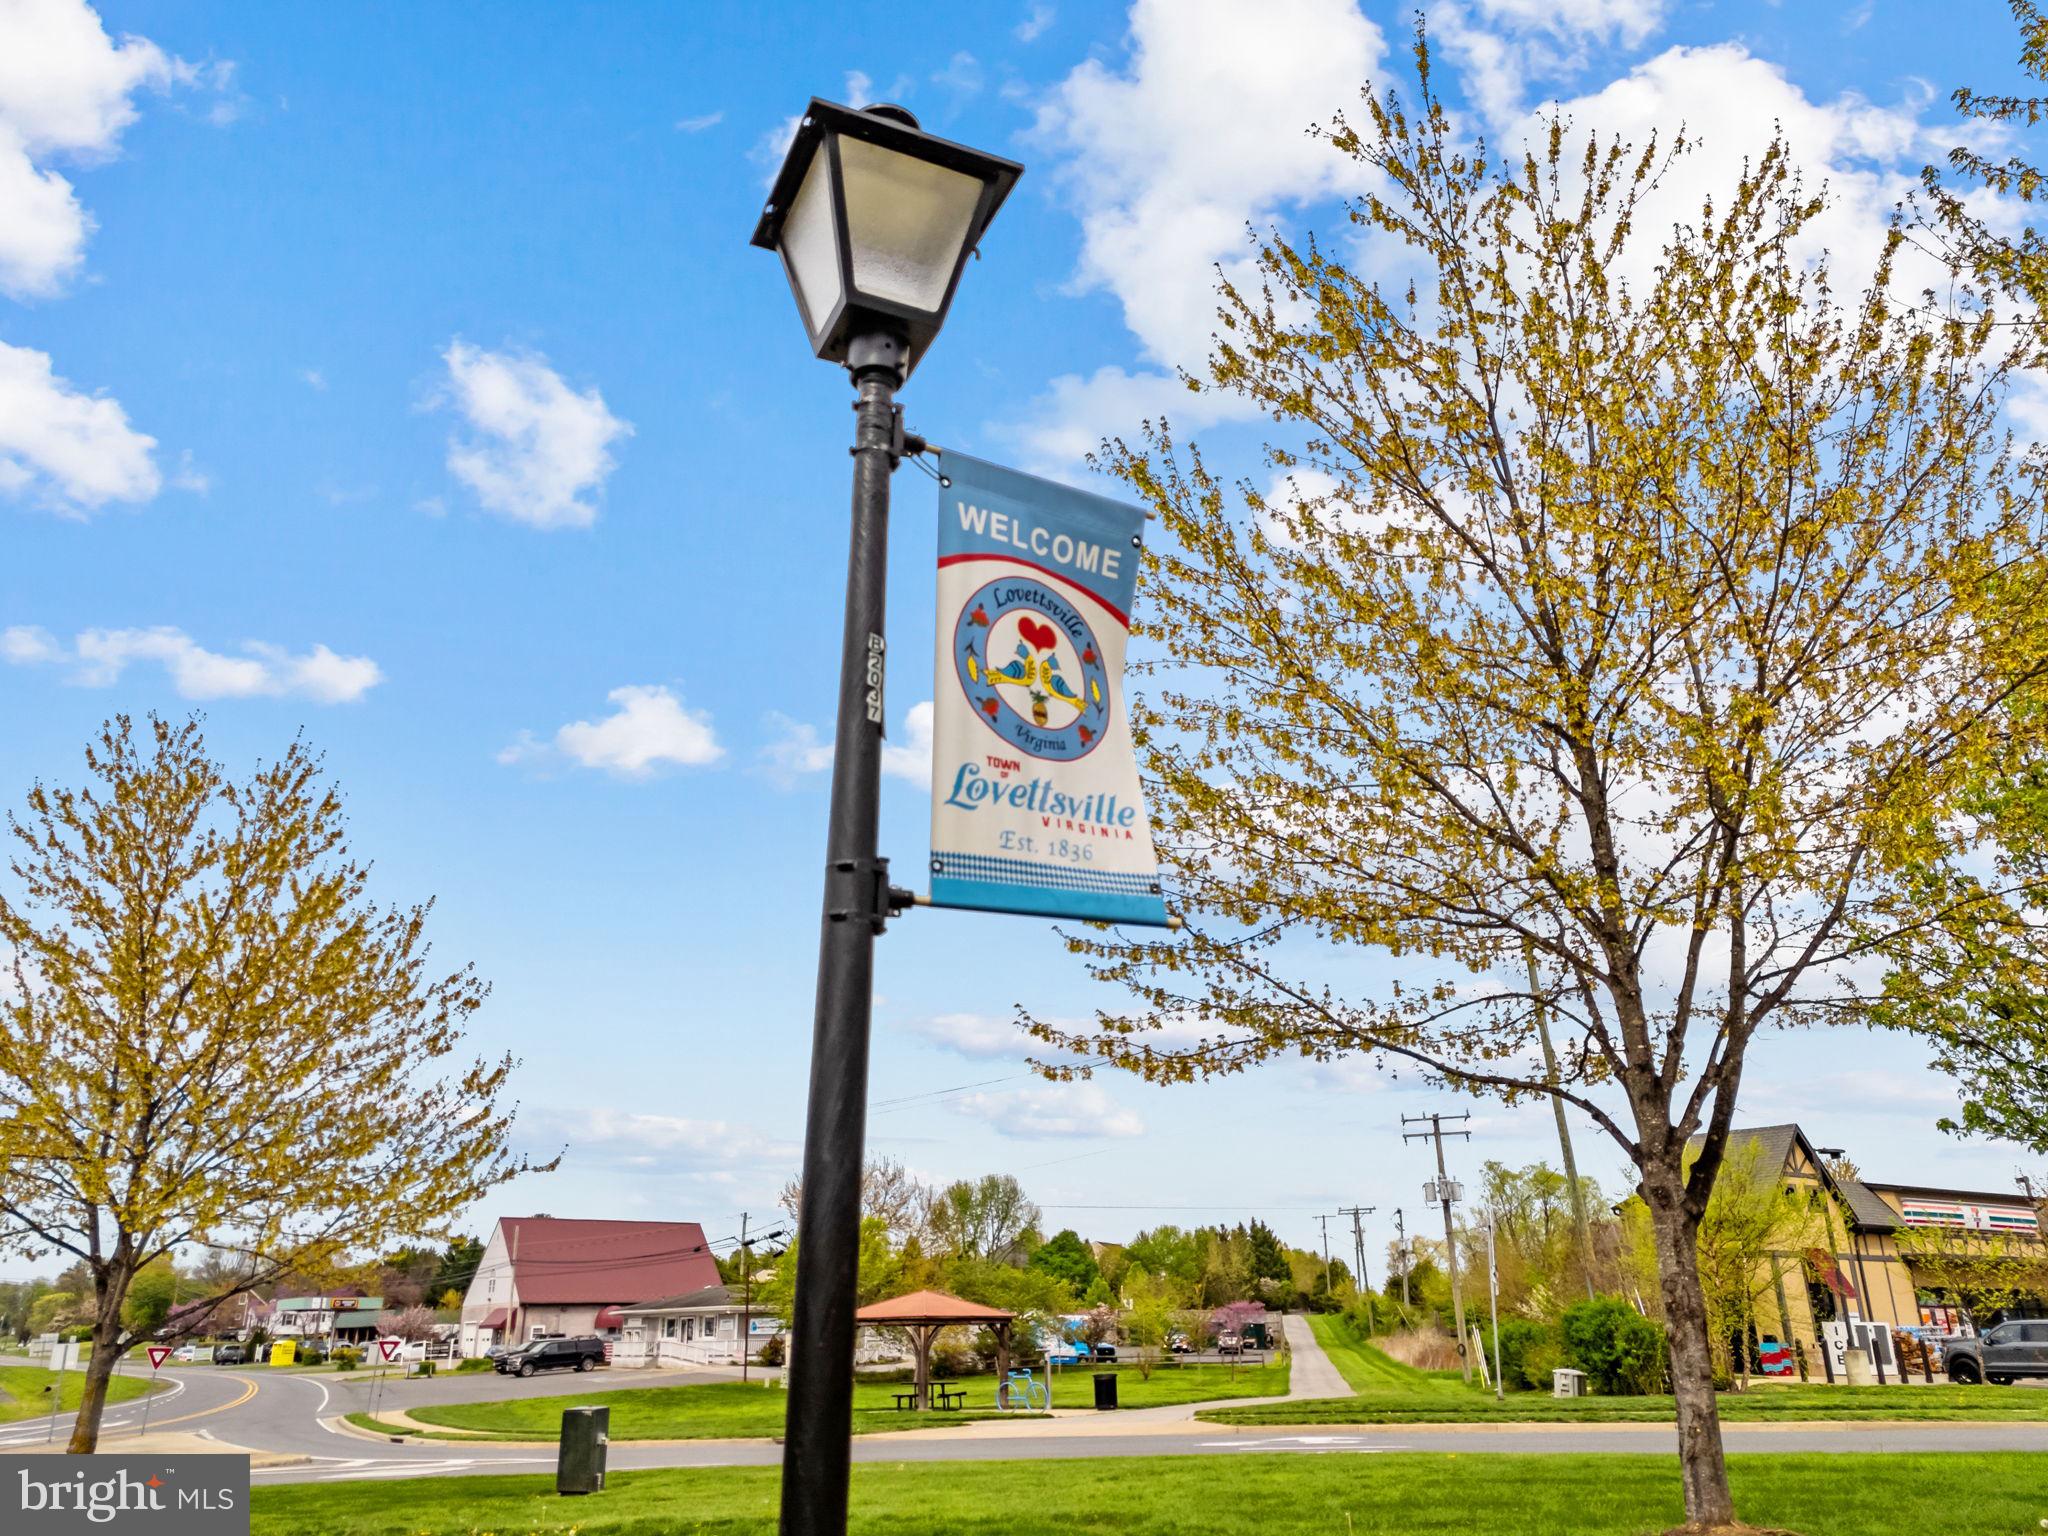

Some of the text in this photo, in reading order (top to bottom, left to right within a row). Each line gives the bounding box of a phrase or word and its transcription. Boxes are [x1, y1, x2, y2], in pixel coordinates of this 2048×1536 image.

[958, 502, 1121, 579] WELCOME
[993, 587, 1083, 638] Lovettsville
[1015, 722, 1066, 752] Virginia
[986, 755, 1020, 772] TOWN
[944, 762, 1136, 828] Lovettsville
[1042, 816, 1133, 840] VIRGINIA
[1000, 830, 1093, 862] Est. 1836
[1834, 1326, 1845, 1365] ICE
